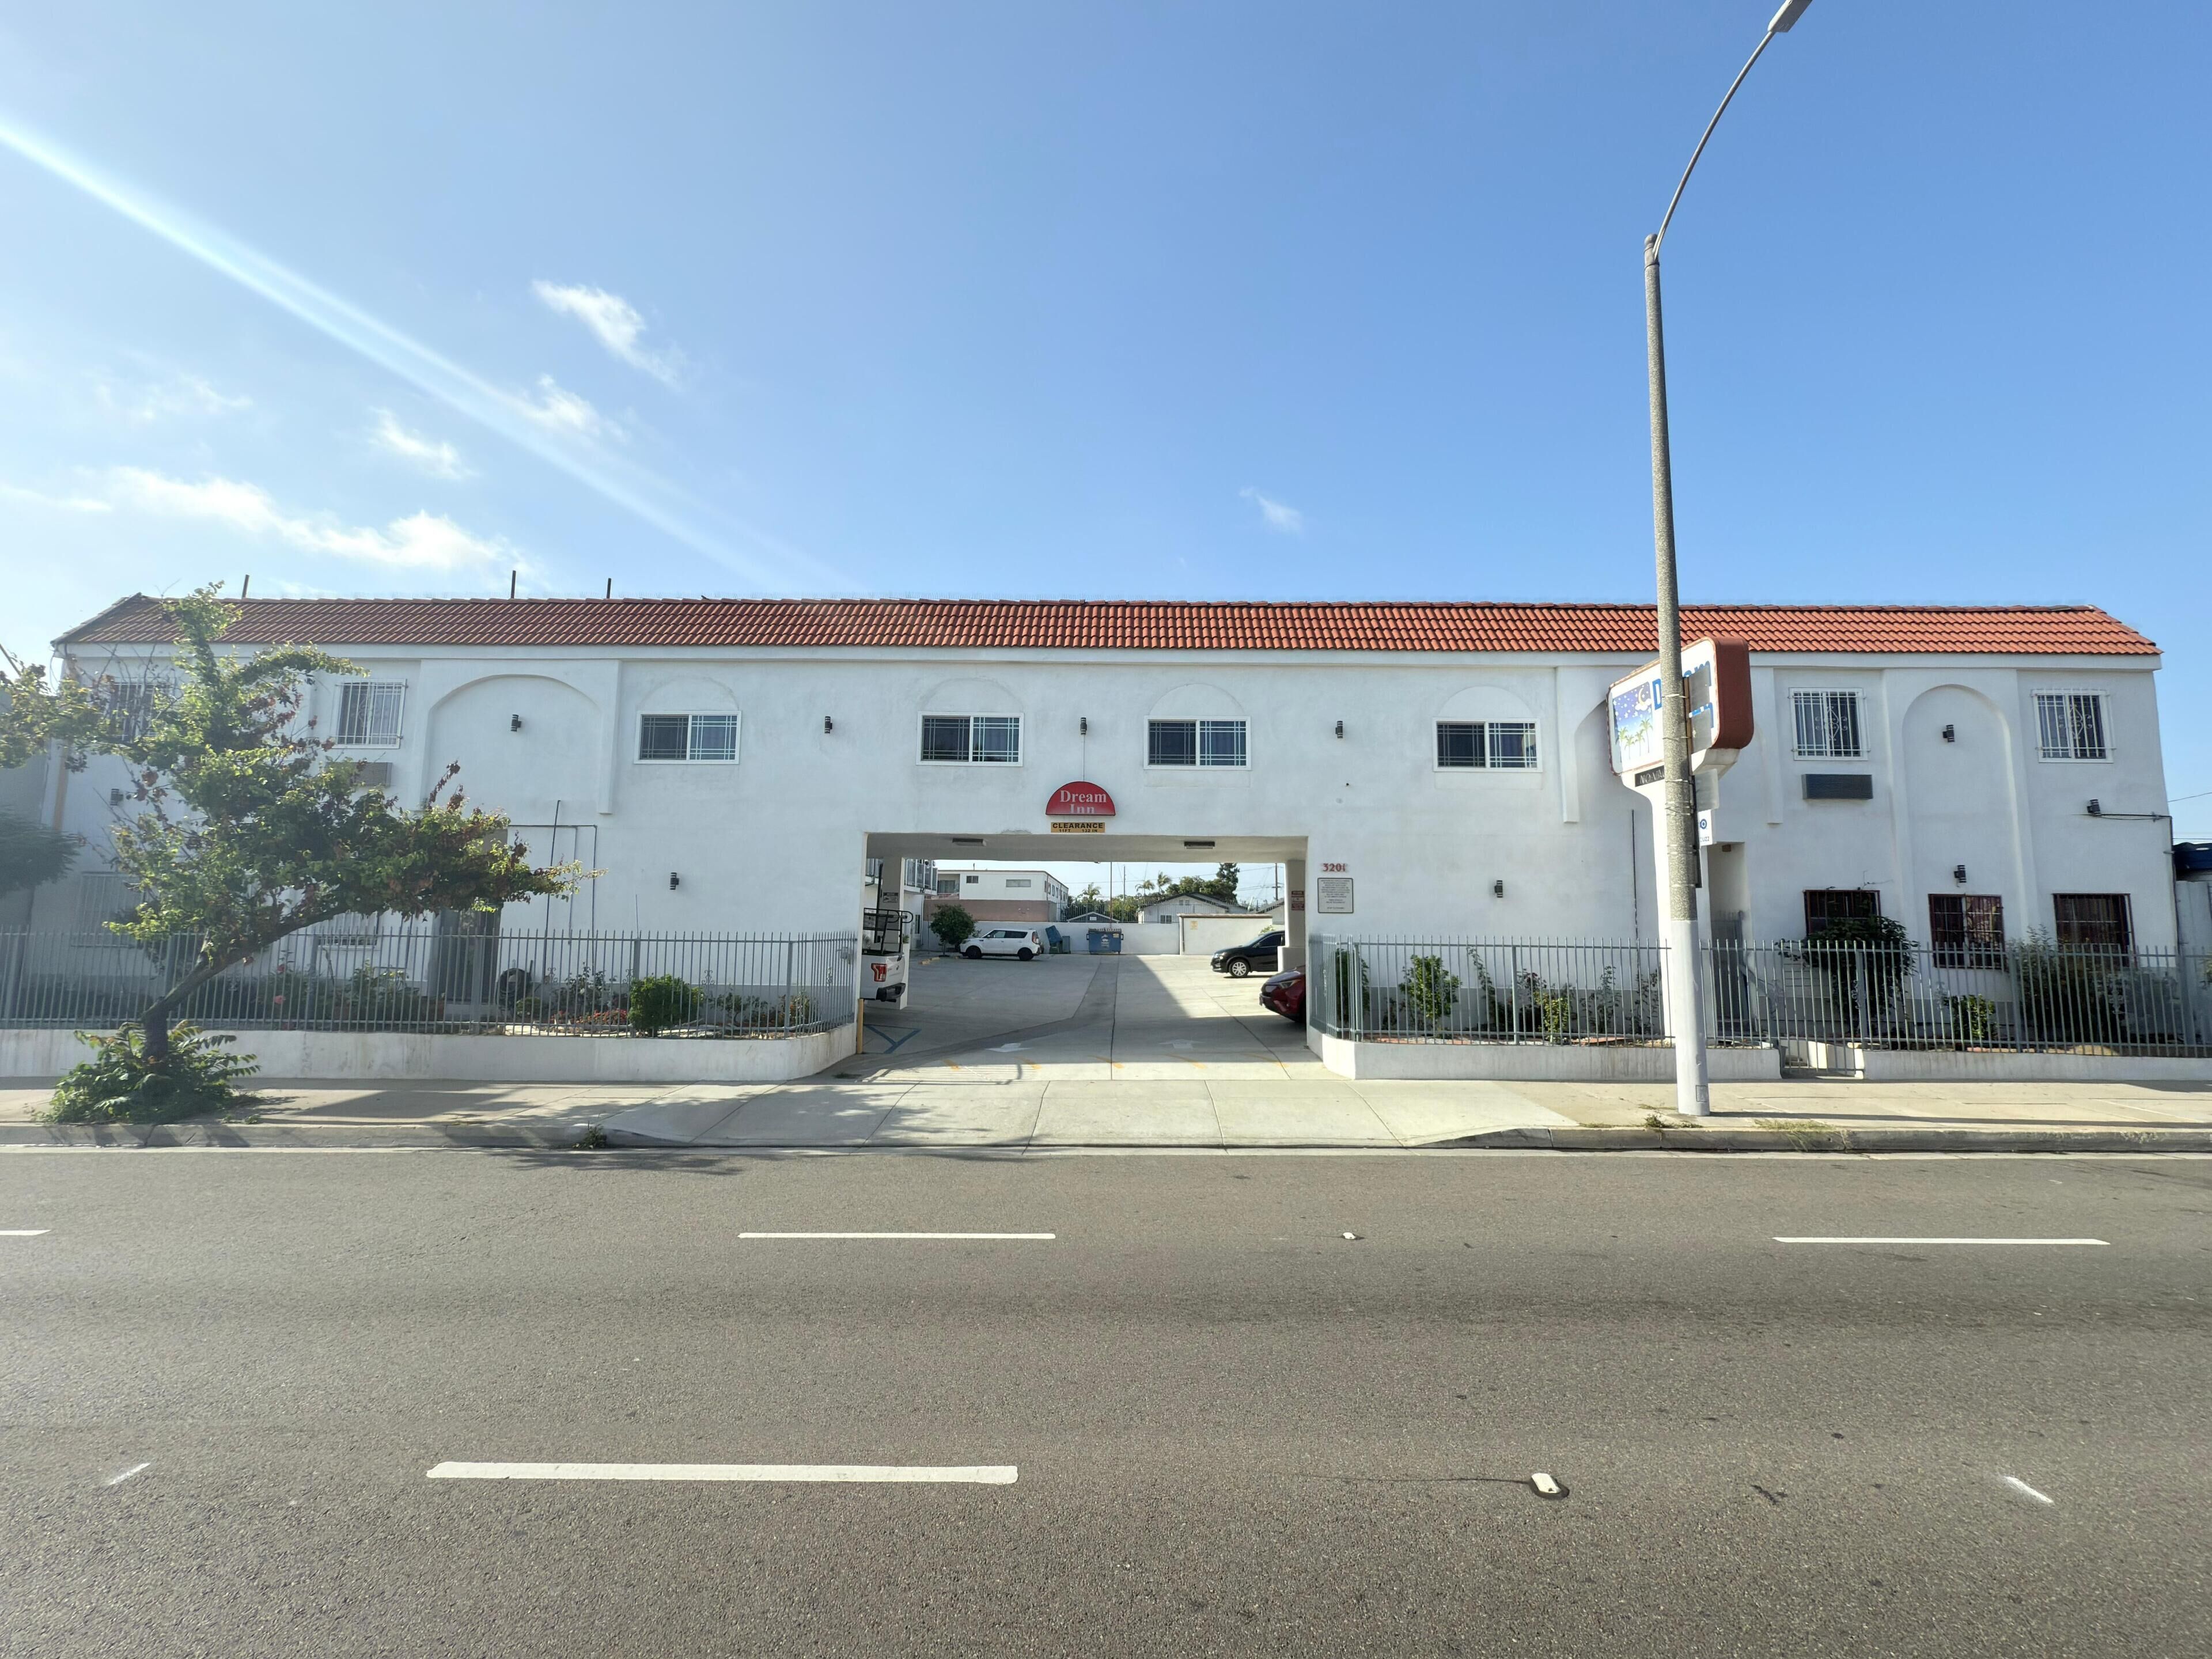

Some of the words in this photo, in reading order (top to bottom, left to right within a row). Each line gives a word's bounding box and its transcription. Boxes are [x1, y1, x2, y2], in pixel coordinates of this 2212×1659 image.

[1060, 790, 1107, 802] Dream
[1070, 804, 1095, 813] Inn
[1323, 863, 1346, 872] 3201
